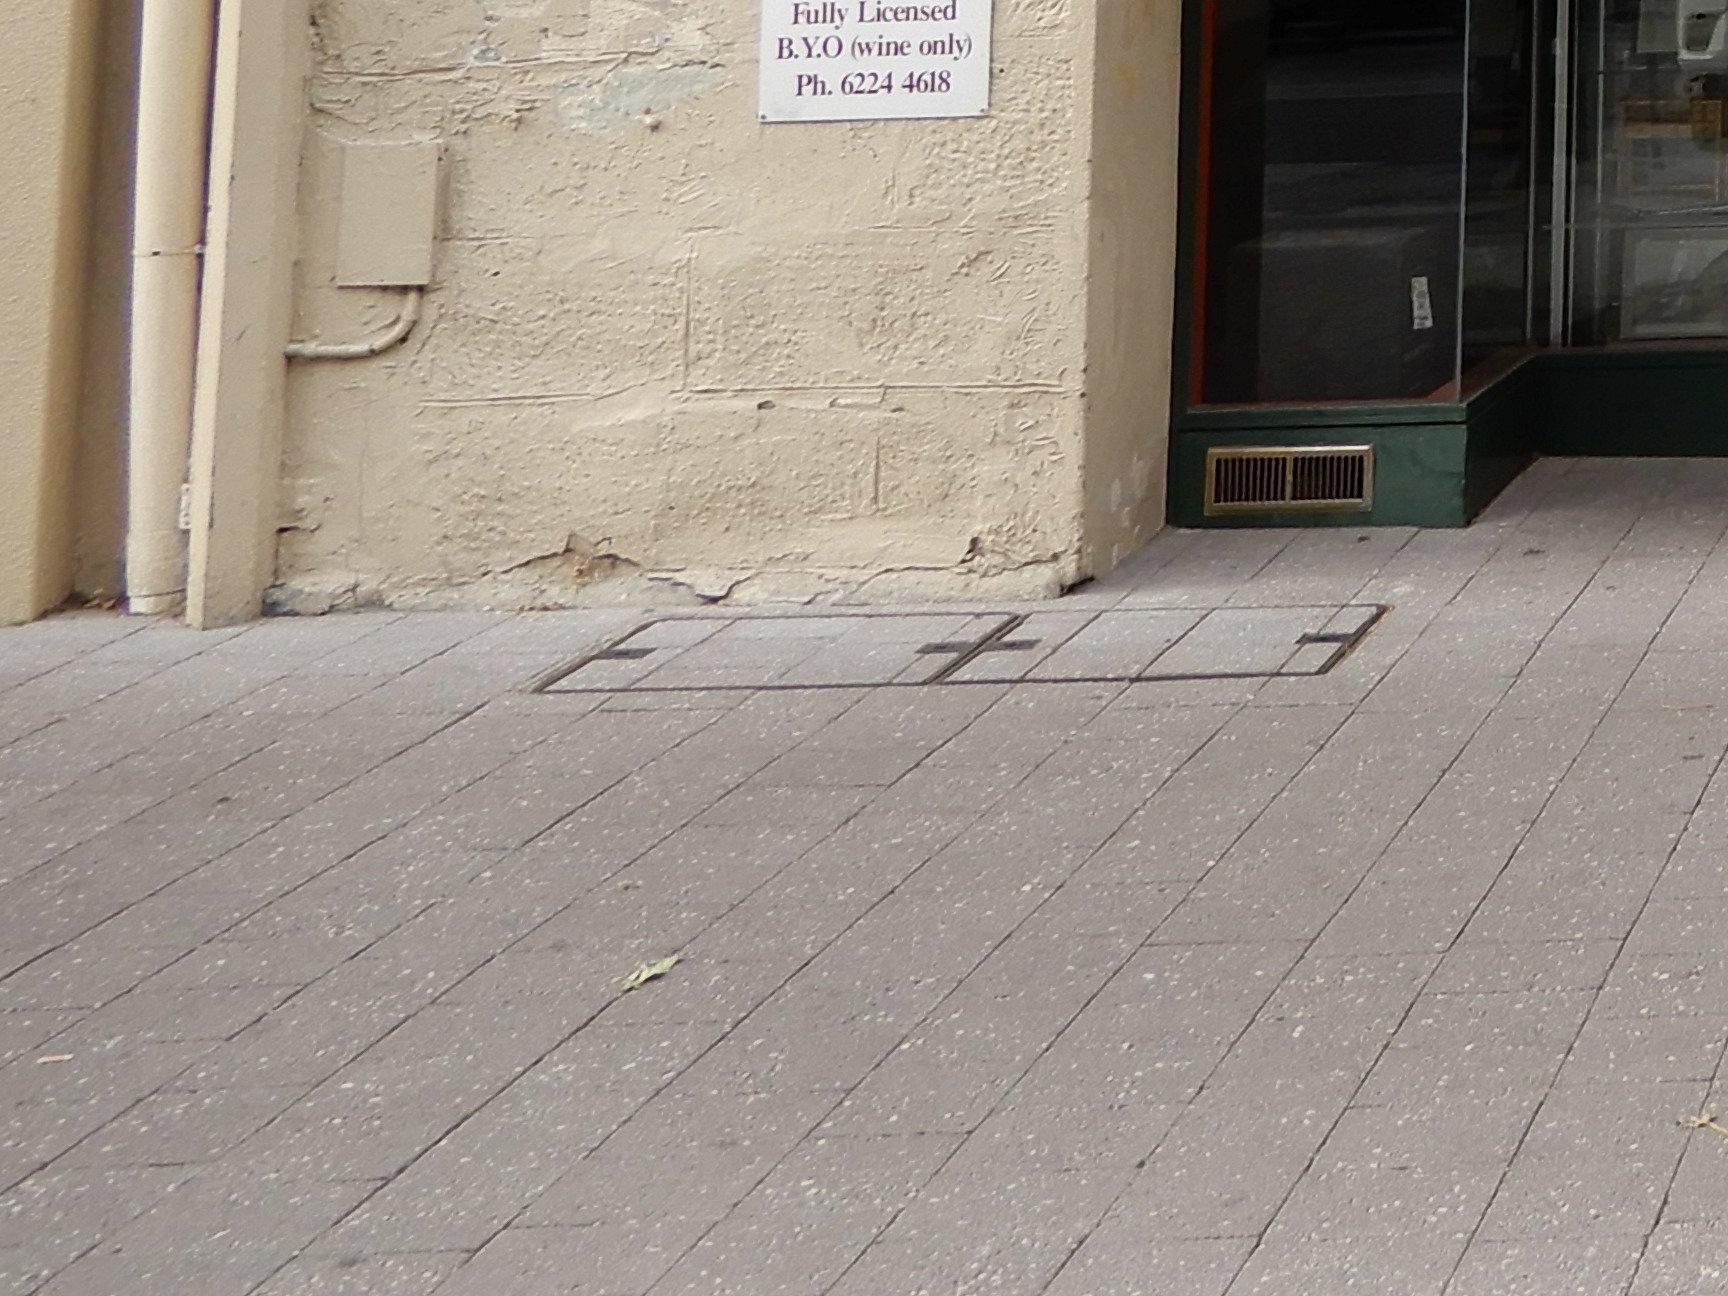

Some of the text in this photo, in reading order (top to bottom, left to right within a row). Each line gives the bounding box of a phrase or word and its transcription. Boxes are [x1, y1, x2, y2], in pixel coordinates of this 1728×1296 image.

[793, 0, 957, 30] Fully Licensed
[777, 32, 973, 61] B.Y.O (wine only)
[795, 70, 951, 96] Ph. 6224 4618
